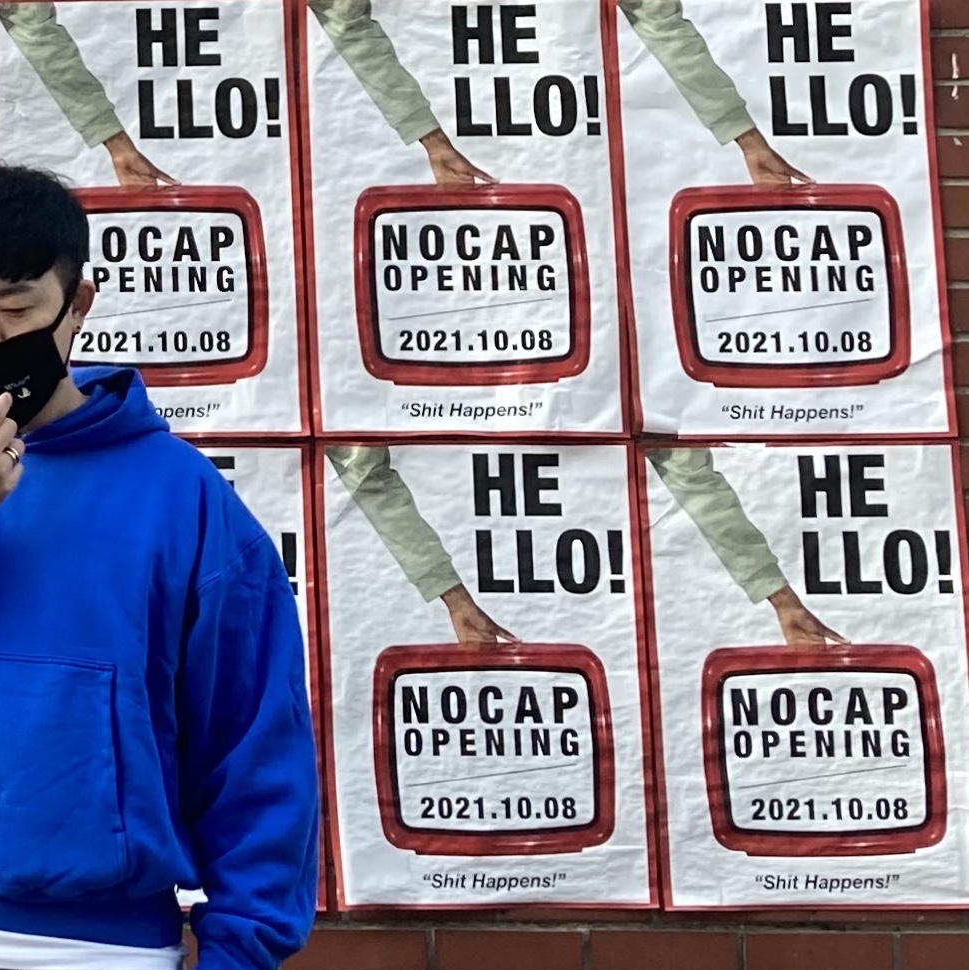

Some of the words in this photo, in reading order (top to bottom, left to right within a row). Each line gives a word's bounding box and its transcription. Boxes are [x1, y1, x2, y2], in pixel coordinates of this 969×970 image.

[135, 7, 222, 68] HE
[451, 4, 540, 65] HE
[765, 2, 855, 63] HE
[137, 77, 282, 140] LLO!
[455, 74, 602, 136] LLO!
[768, 73, 918, 137] LLO!
[101, 225, 235, 263] OCAP
[381, 224, 555, 261] NOCAP
[698, 225, 872, 262] NOCAP
[92, 266, 235, 293] PENING
[383, 264, 556, 292] OPENING
[700, 265, 874, 293] OPENING
[81, 331, 231, 352] 2021.10.08
[399, 329, 553, 352] 2021.10.08
[717, 331, 872, 353] 2021.10.08
[471, 453, 563, 517] HE
[797, 454, 889, 519] HE
[475, 528, 626, 595] LLO!
[802, 529, 954, 595] LLO!
[401, 685, 579, 725] NOCAP
[730, 687, 908, 726] NOCAP
[403, 728, 579, 757] OPENING
[733, 729, 910, 759] OPENING
[420, 797, 577, 820] 2021.10.08
[751, 798, 908, 822] 2021.10.08
